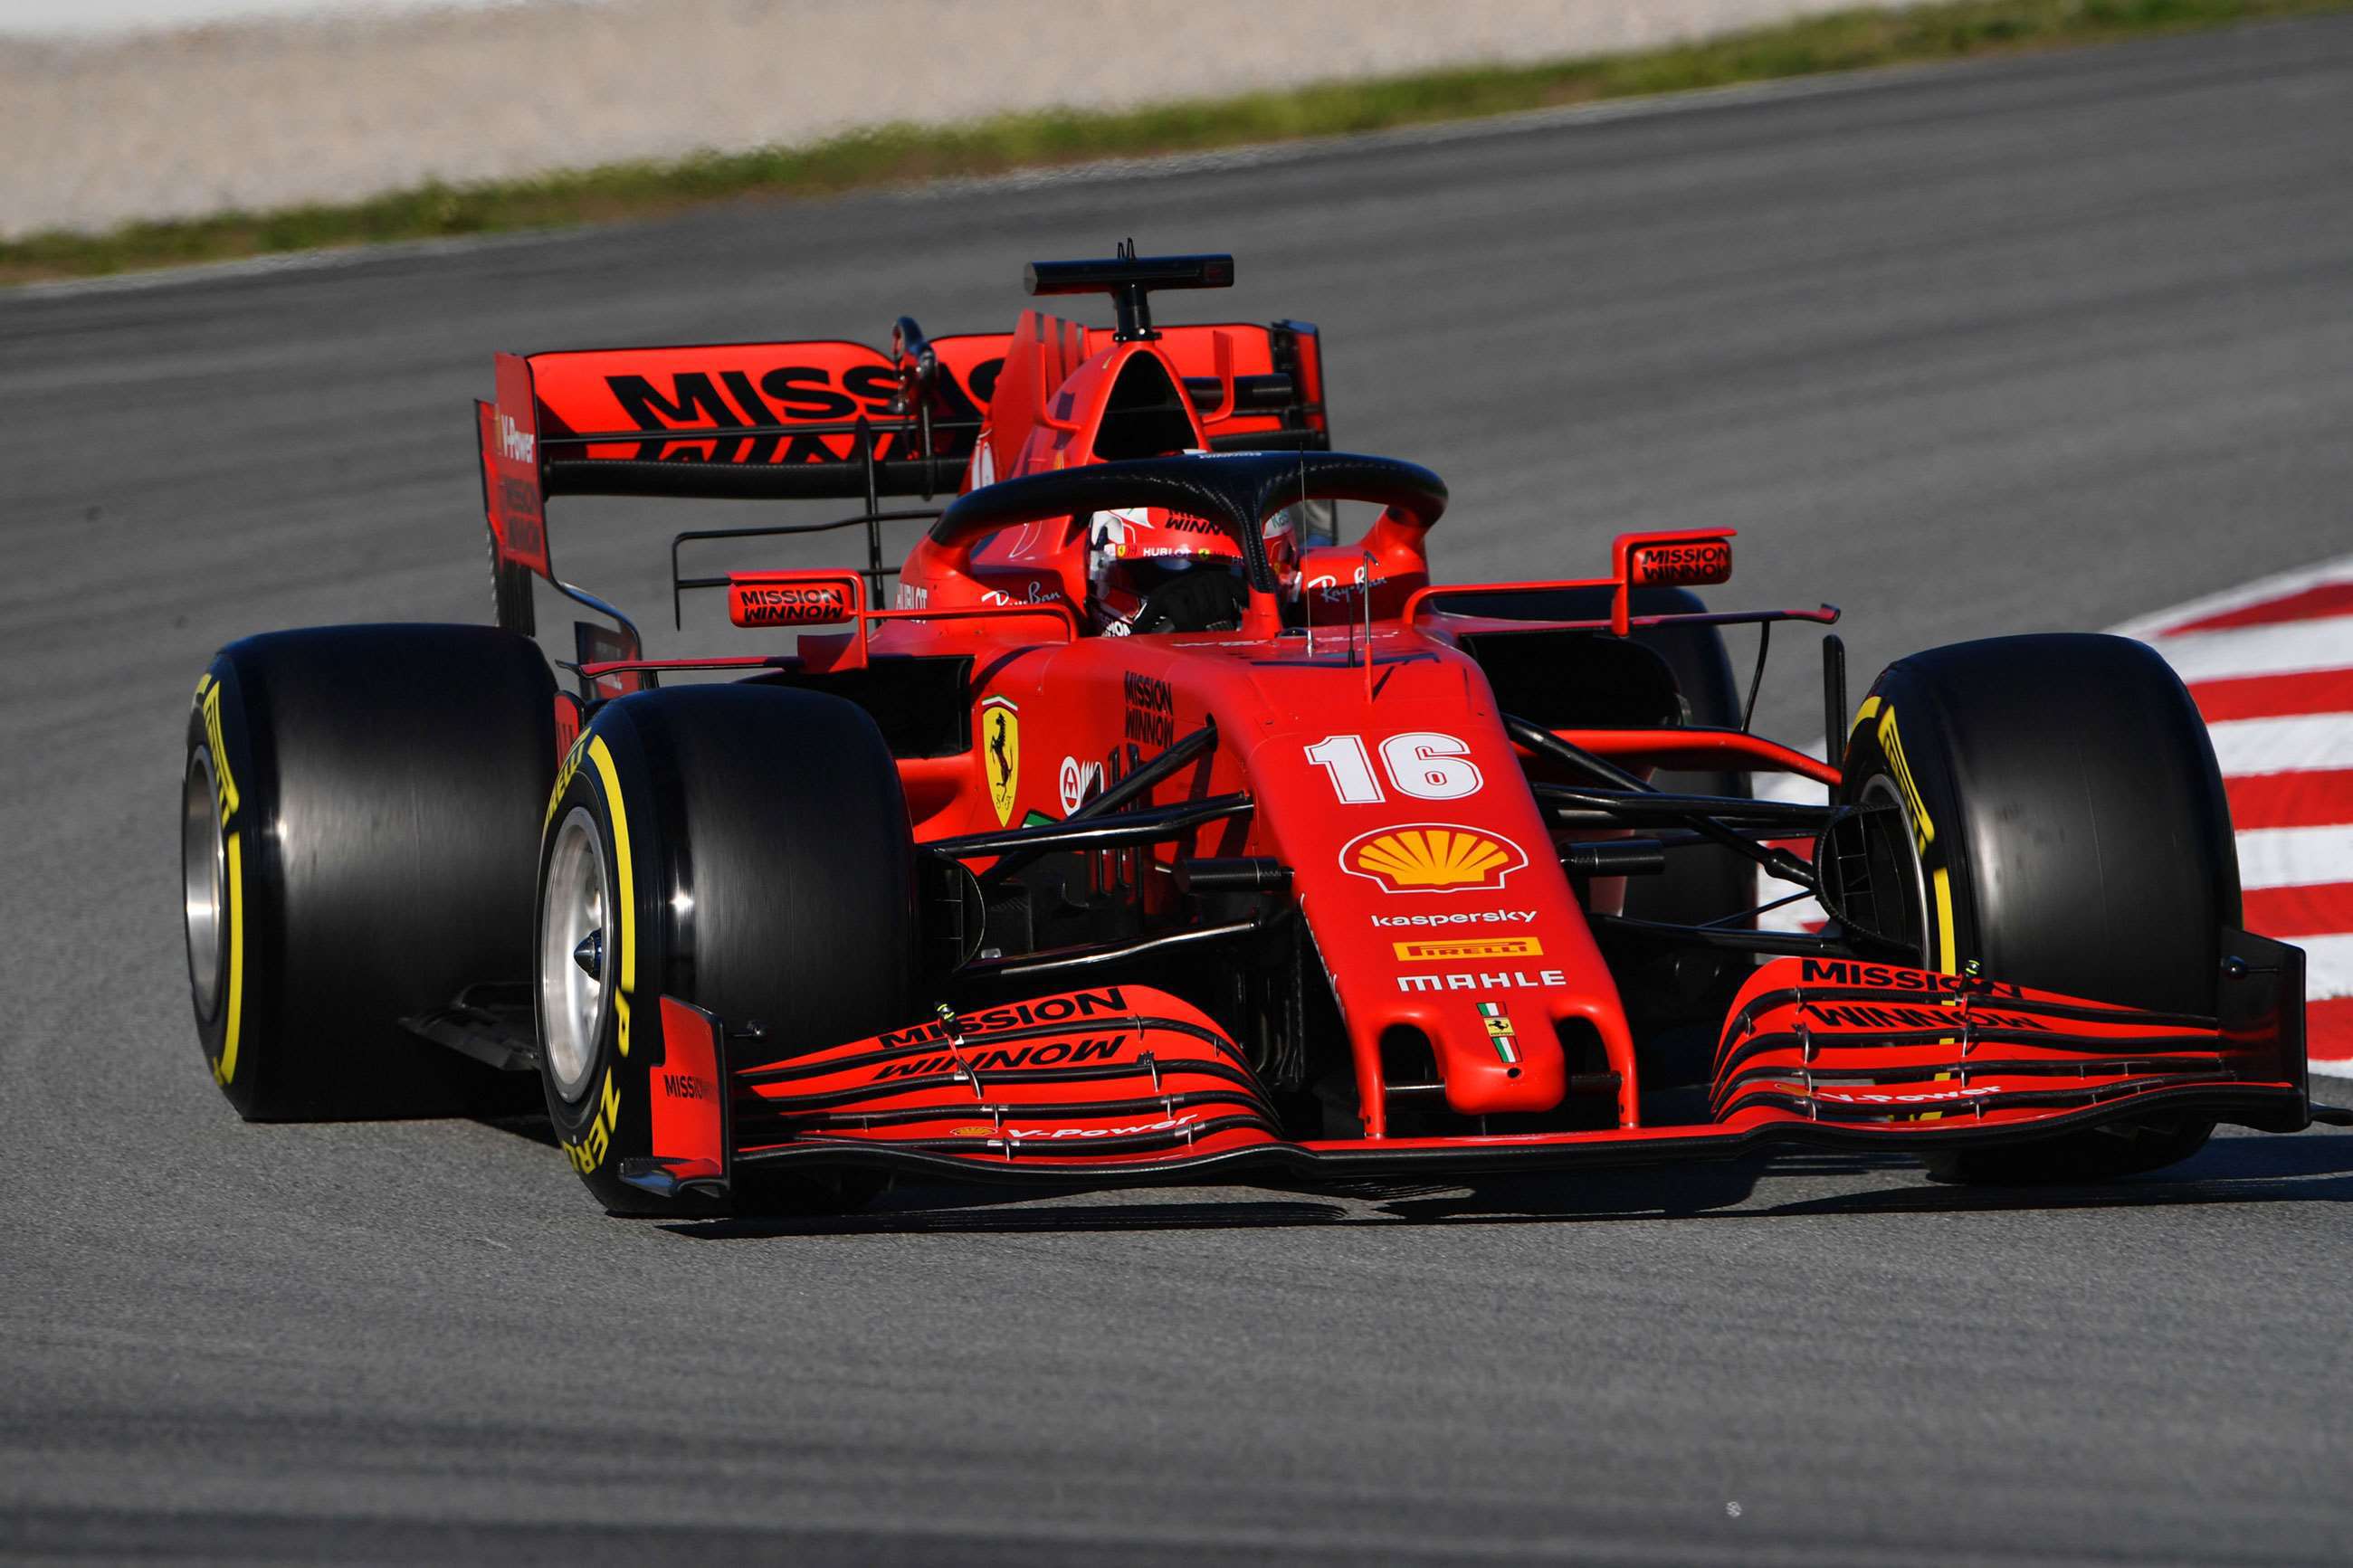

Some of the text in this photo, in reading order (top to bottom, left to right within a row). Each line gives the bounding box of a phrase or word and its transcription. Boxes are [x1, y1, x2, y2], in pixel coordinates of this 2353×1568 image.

[1165, 517, 1236, 537] WINN
[1642, 546, 1729, 565] MISSION
[740, 589, 843, 605] MISSION
[743, 604, 844, 622] WINNOW
[1124, 670, 1174, 717] MISSION
[1125, 706, 1174, 749] WINNOW
[1303, 731, 1484, 804] 16
[1371, 909, 1538, 927] kaspersky
[1406, 940, 1528, 957] PIRELLI
[1396, 970, 1567, 993] MAHLE
[878, 987, 1128, 1050] MISSION
[1804, 1004, 2053, 1031] WINNOW
[872, 1035, 1128, 1080] WINNOW
[1818, 1086, 2002, 1103] V-Power
[1008, 1114, 1198, 1137] V-Power
